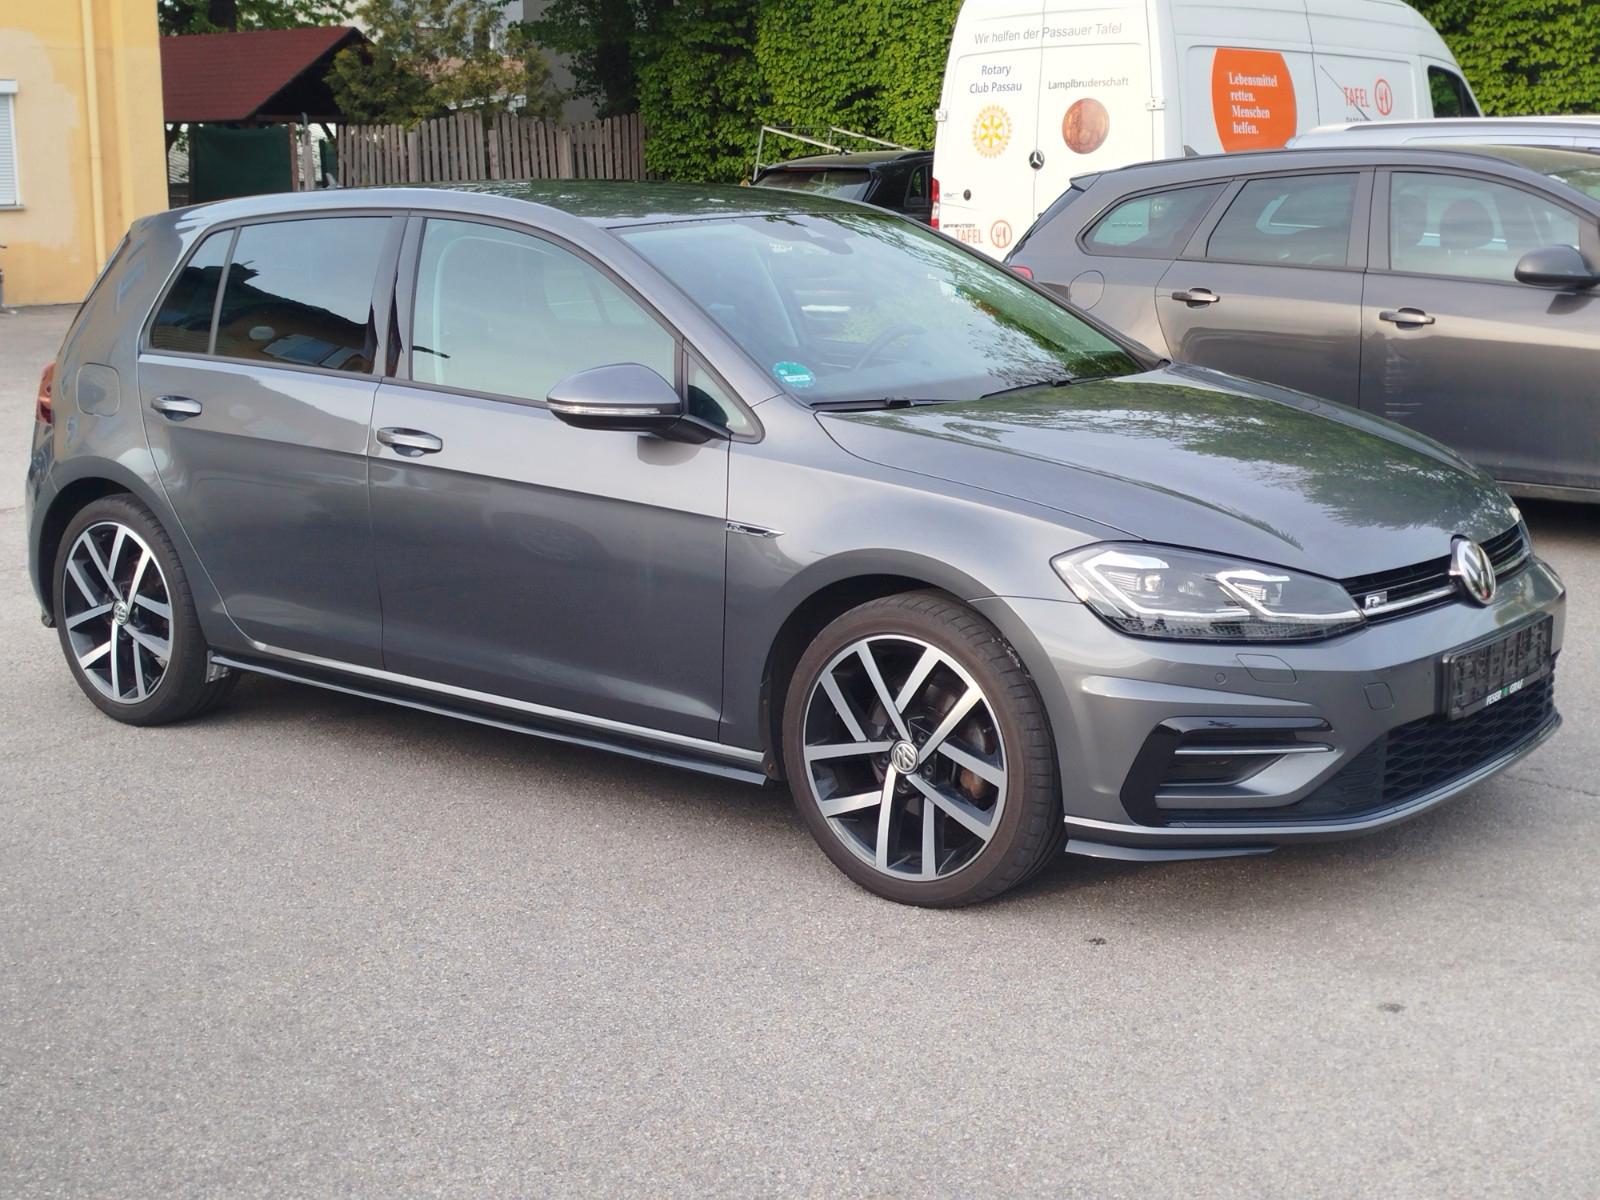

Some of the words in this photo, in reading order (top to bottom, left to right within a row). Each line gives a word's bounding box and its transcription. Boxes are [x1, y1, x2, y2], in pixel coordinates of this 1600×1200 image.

[974, 32, 990, 44] Wir
[991, 30, 1020, 42] helfen
[1023, 28, 1040, 40] der
[1041, 25, 1093, 38] Passauer
[1095, 22, 1122, 35] Tafel
[981, 64, 1011, 77] Rotary
[1228, 71, 1278, 88] Lebensmittel
[969, 82, 989, 94] Club
[991, 81, 1022, 92] Passau
[1230, 90, 1256, 102] retten.
[1343, 86, 1370, 108] TAFEL
[1231, 104, 1271, 119] Menschen
[1232, 121, 1260, 135] helfen.
[955, 228, 983, 244] TAFEL
